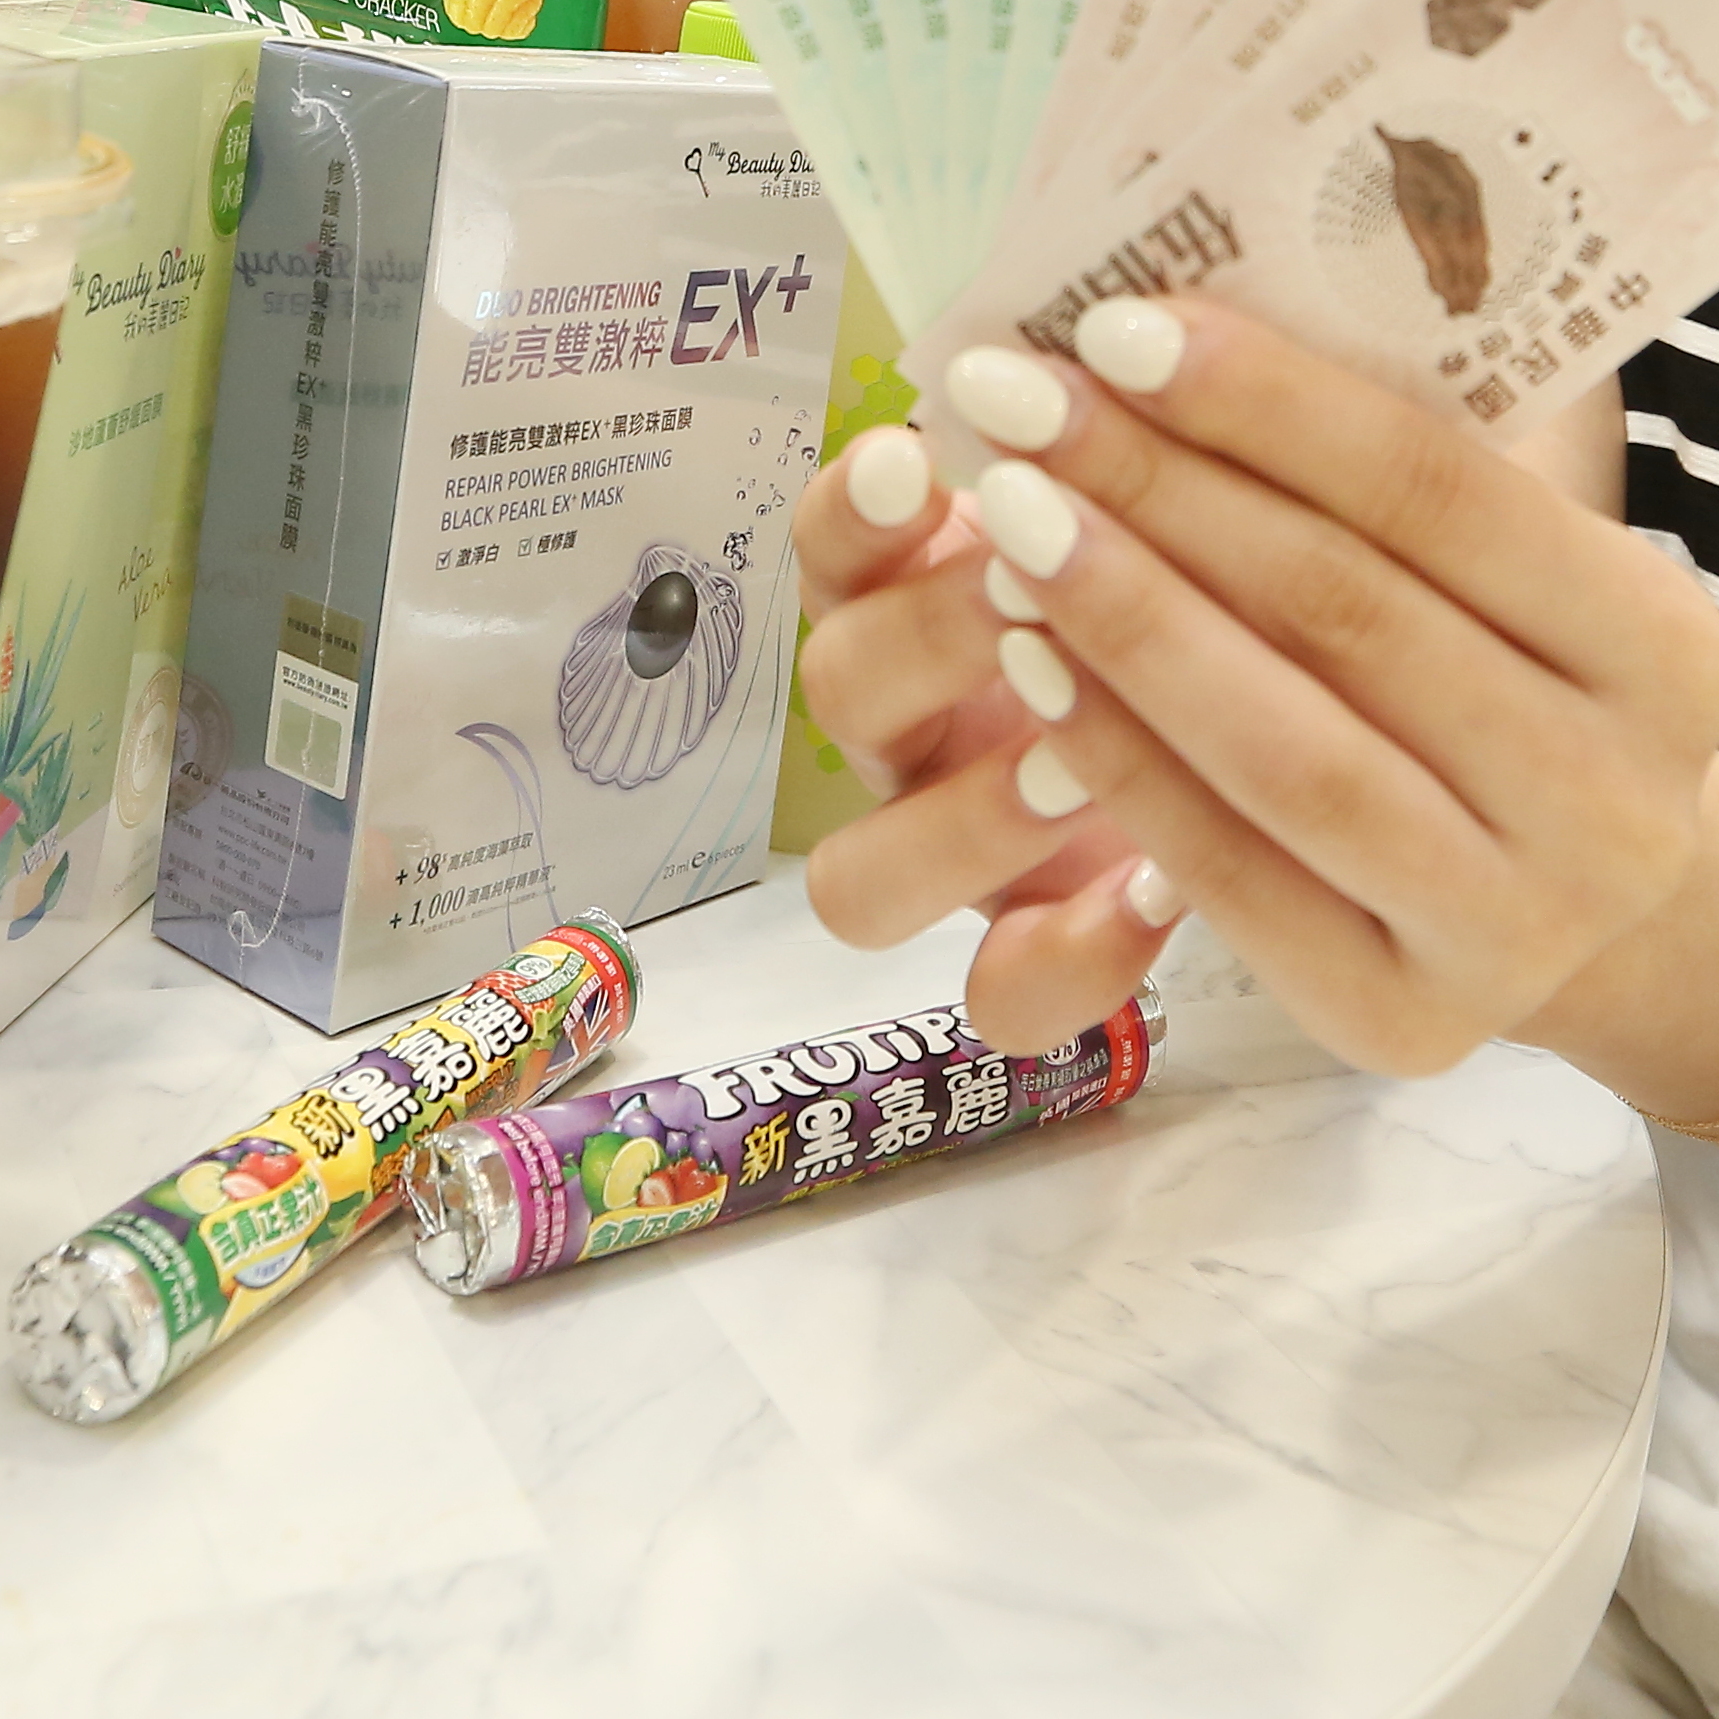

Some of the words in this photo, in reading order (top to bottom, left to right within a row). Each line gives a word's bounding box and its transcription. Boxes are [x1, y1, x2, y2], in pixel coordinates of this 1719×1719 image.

[727, 150, 785, 181] Beauty
[84, 265, 152, 316] Beauty
[157, 248, 206, 292] Diary
[527, 280, 662, 317] BRIGHTENING
[461, 314, 668, 388] 能亮雙激粹
[1463, 272, 1652, 424] 中華民國
[441, 506, 494, 531] BLACK
[498, 500, 548, 523] PEARL
[580, 485, 626, 510] MASK
[445, 473, 503, 499] REPAIR
[507, 464, 567, 491] POWER
[570, 449, 673, 481] BRIGHTENING
[289, 1094, 355, 1159] 新
[329, 986, 534, 1143] 黑嘉麗
[738, 1110, 792, 1187] 新
[791, 1050, 1011, 1186] 黑嘉麗
